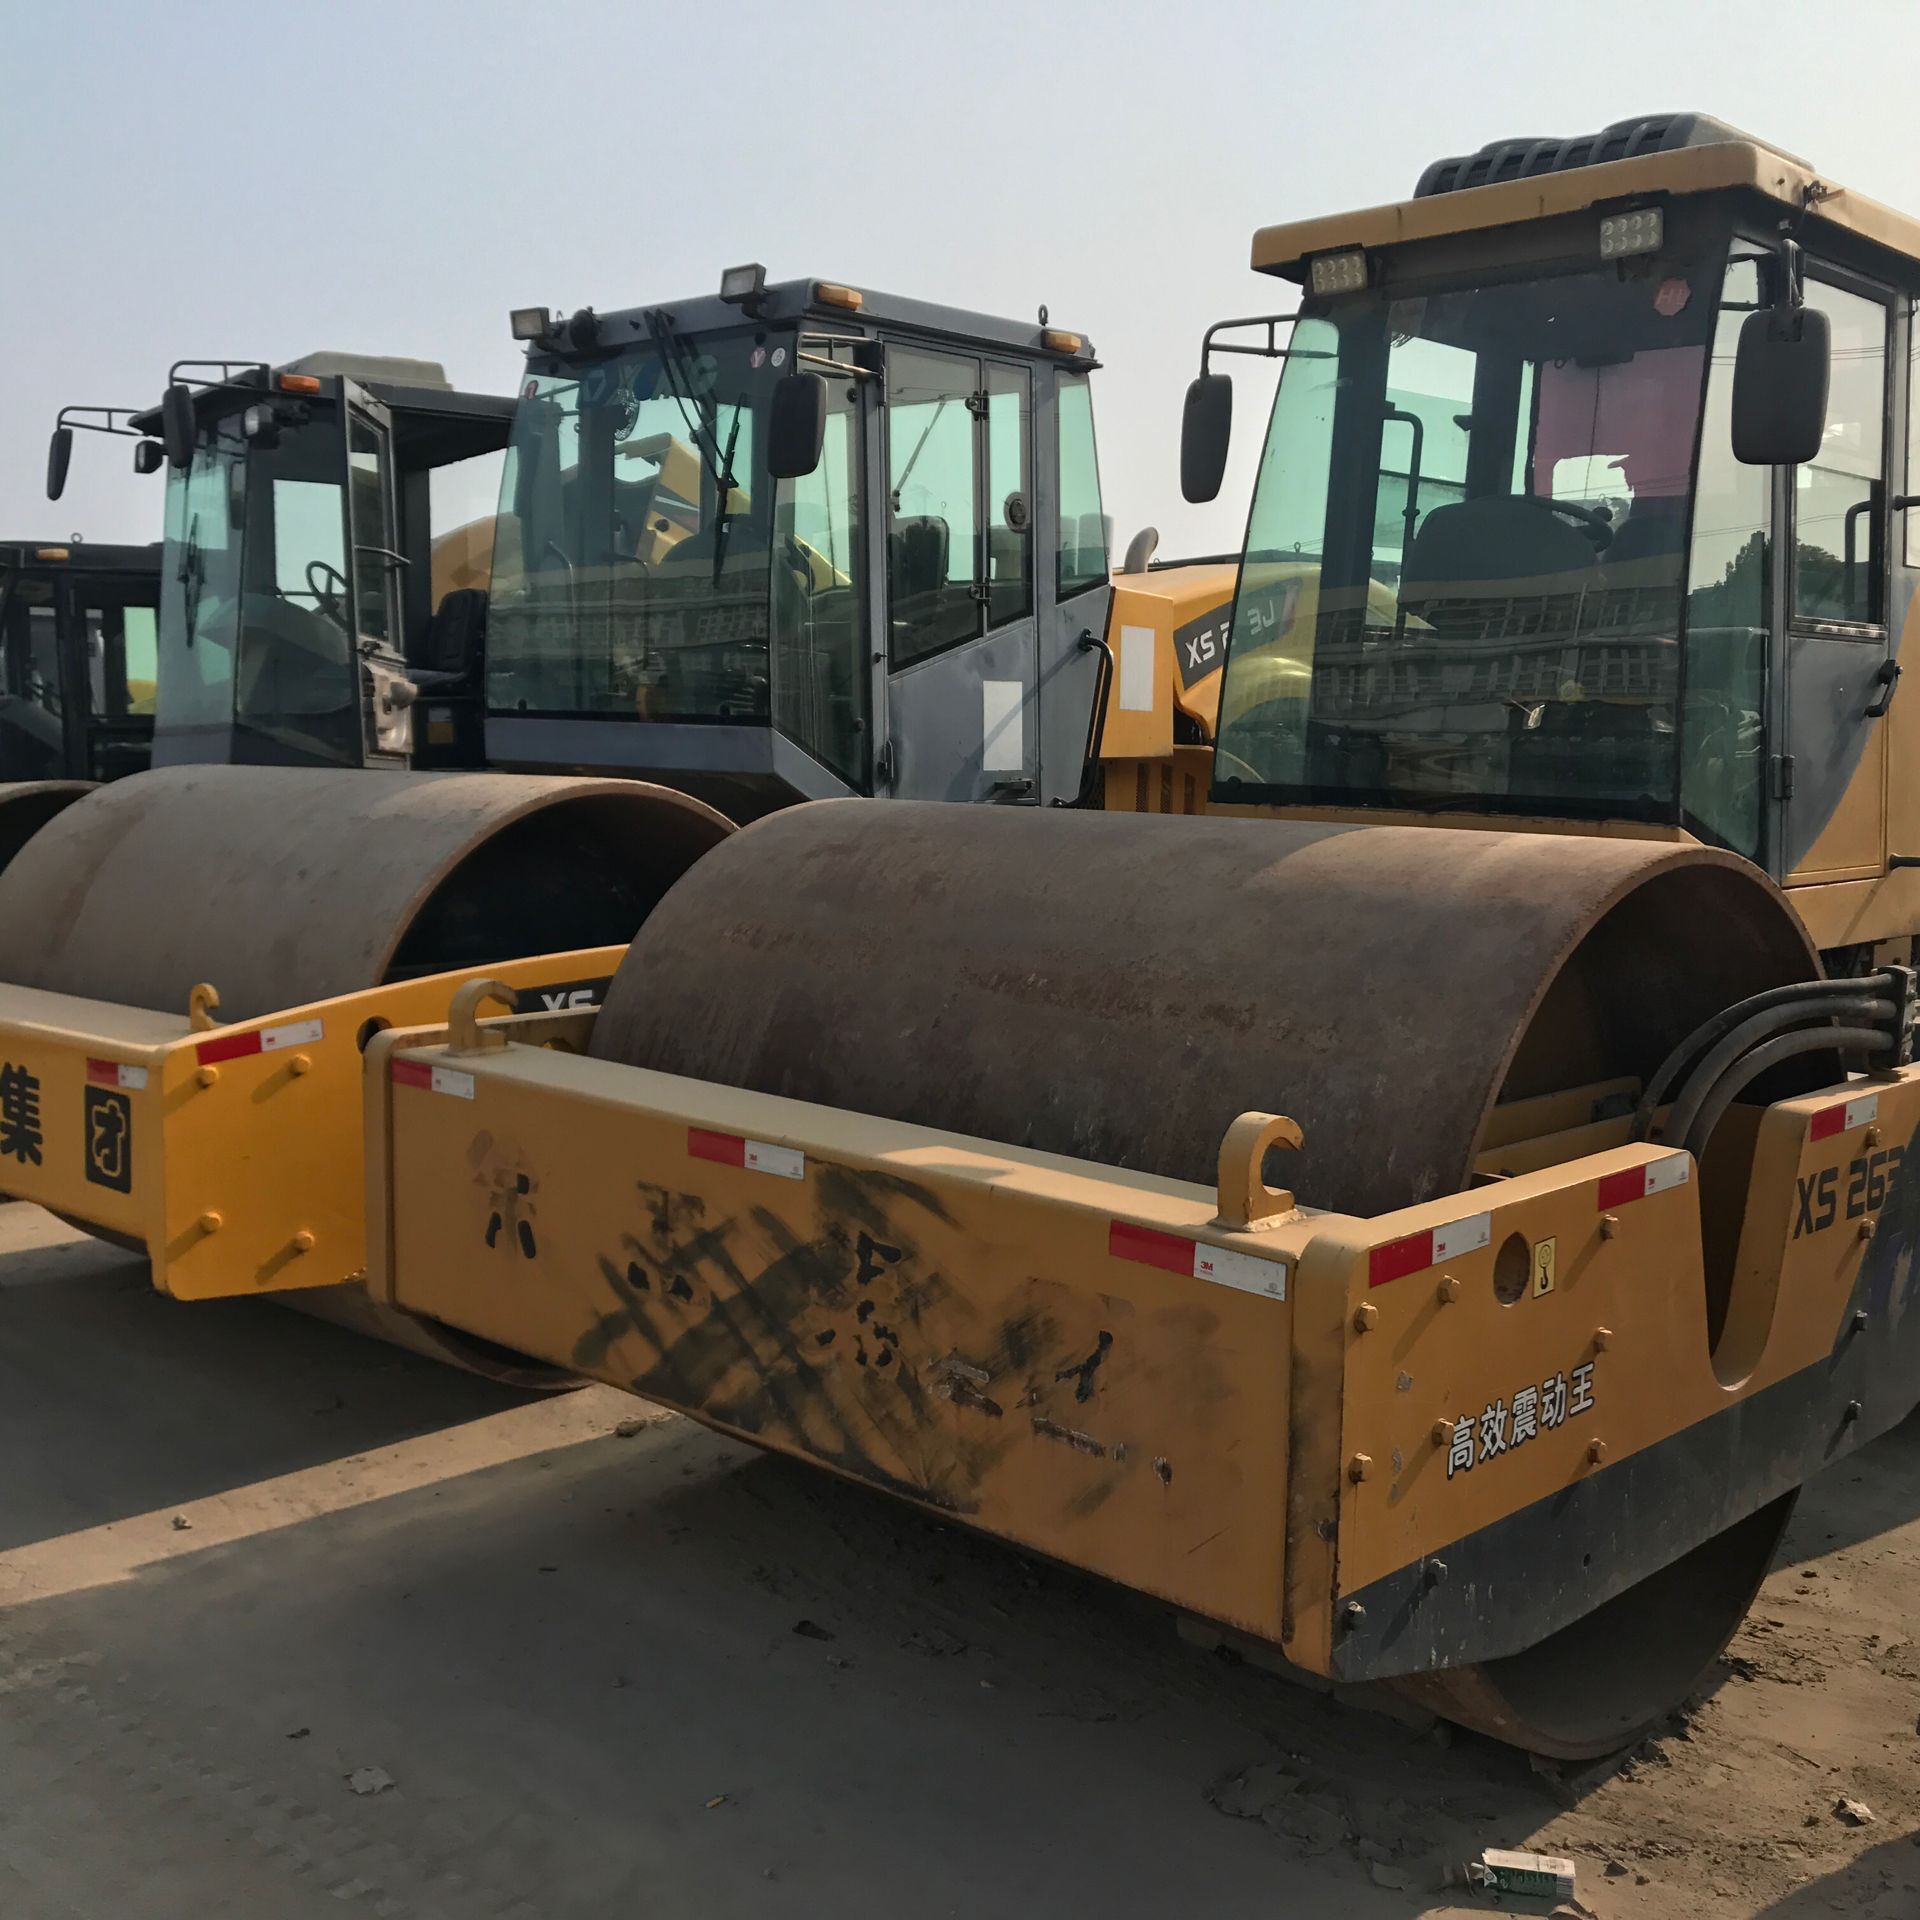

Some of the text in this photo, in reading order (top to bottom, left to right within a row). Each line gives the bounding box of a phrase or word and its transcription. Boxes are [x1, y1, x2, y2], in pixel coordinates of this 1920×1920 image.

[1185, 629, 1216, 669] XS
[1792, 1166, 1839, 1240] XS
[1200, 1260, 1214, 1272] 3M
[1447, 1361, 1595, 1480] 高效震动王
